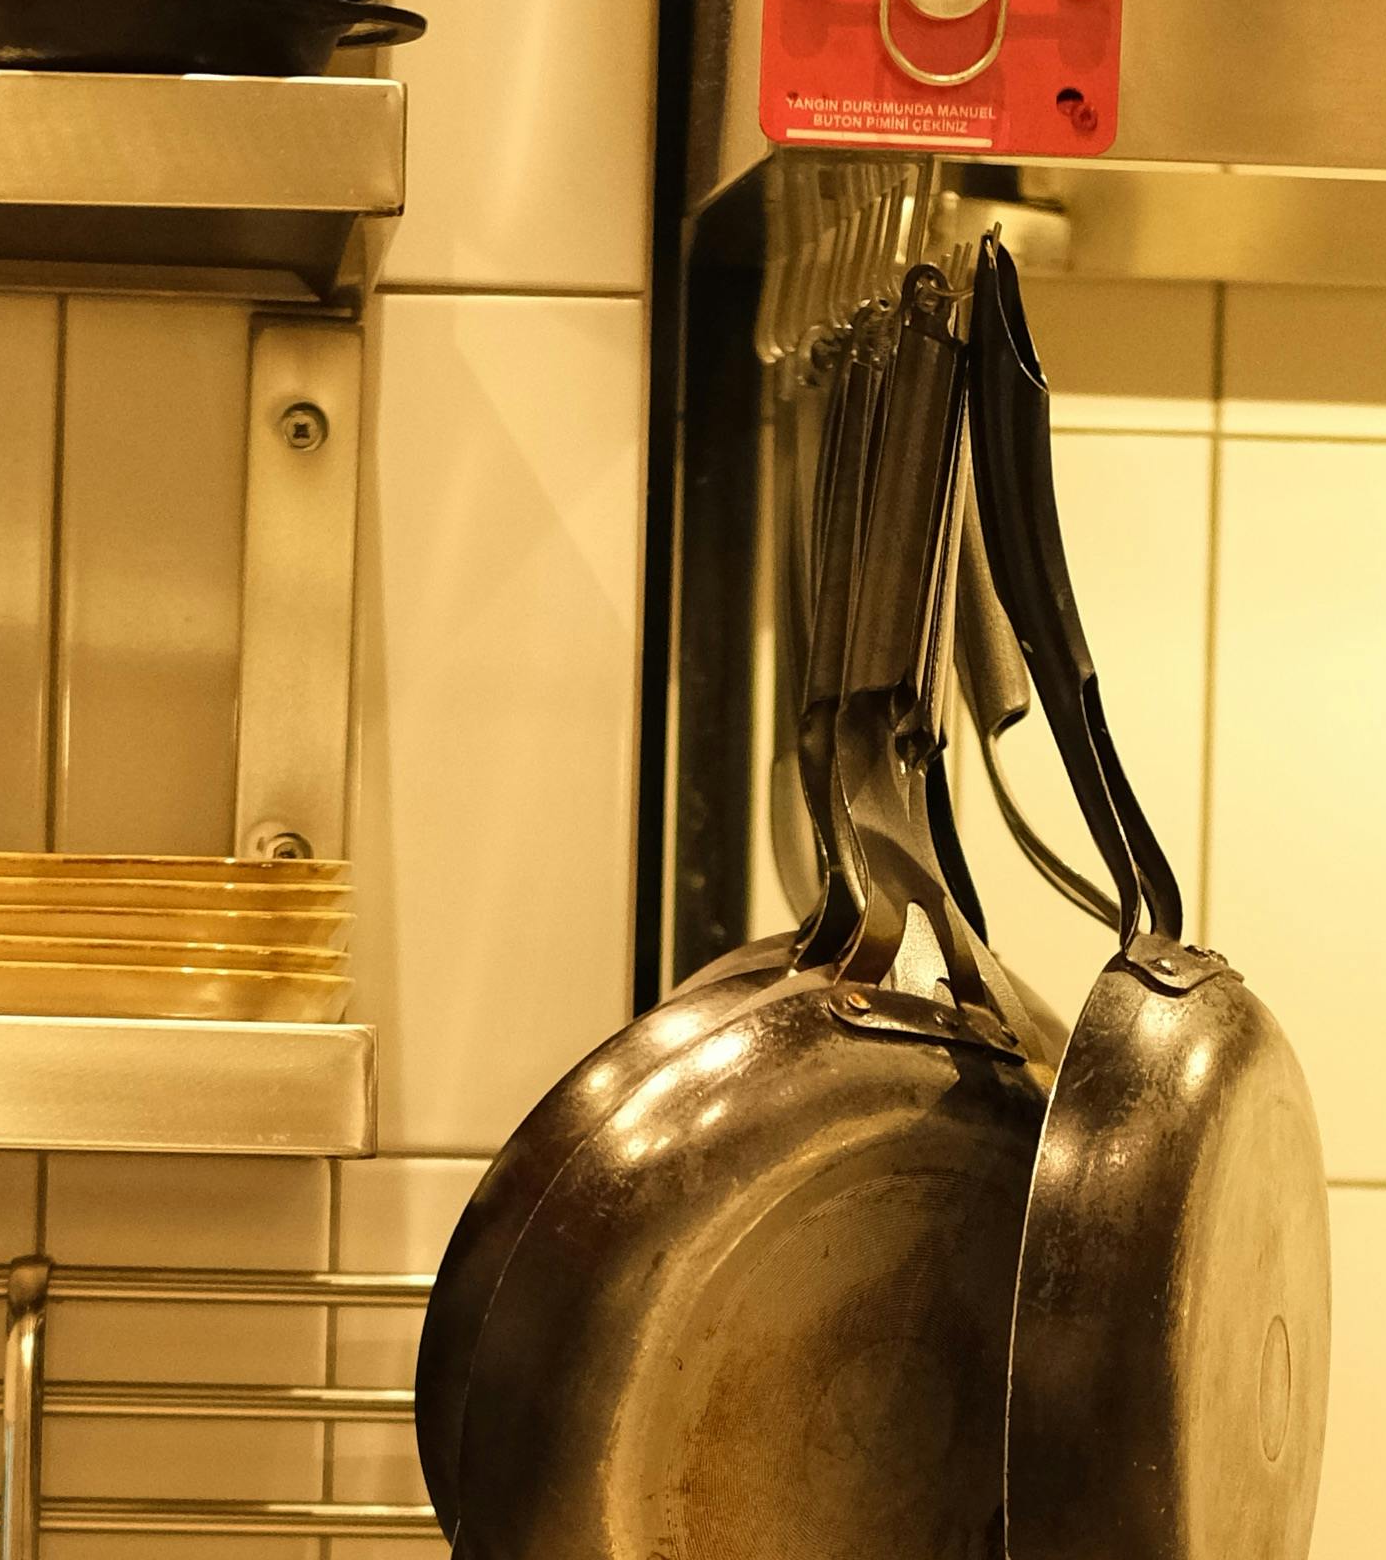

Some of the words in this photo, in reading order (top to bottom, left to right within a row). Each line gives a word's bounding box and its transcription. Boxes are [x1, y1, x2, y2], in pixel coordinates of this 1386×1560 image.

[785, 97, 839, 112] YANGIN
[842, 99, 934, 117] DURUMUNDA
[937, 104, 996, 120] MANUEL
[813, 113, 862, 128] BUTON
